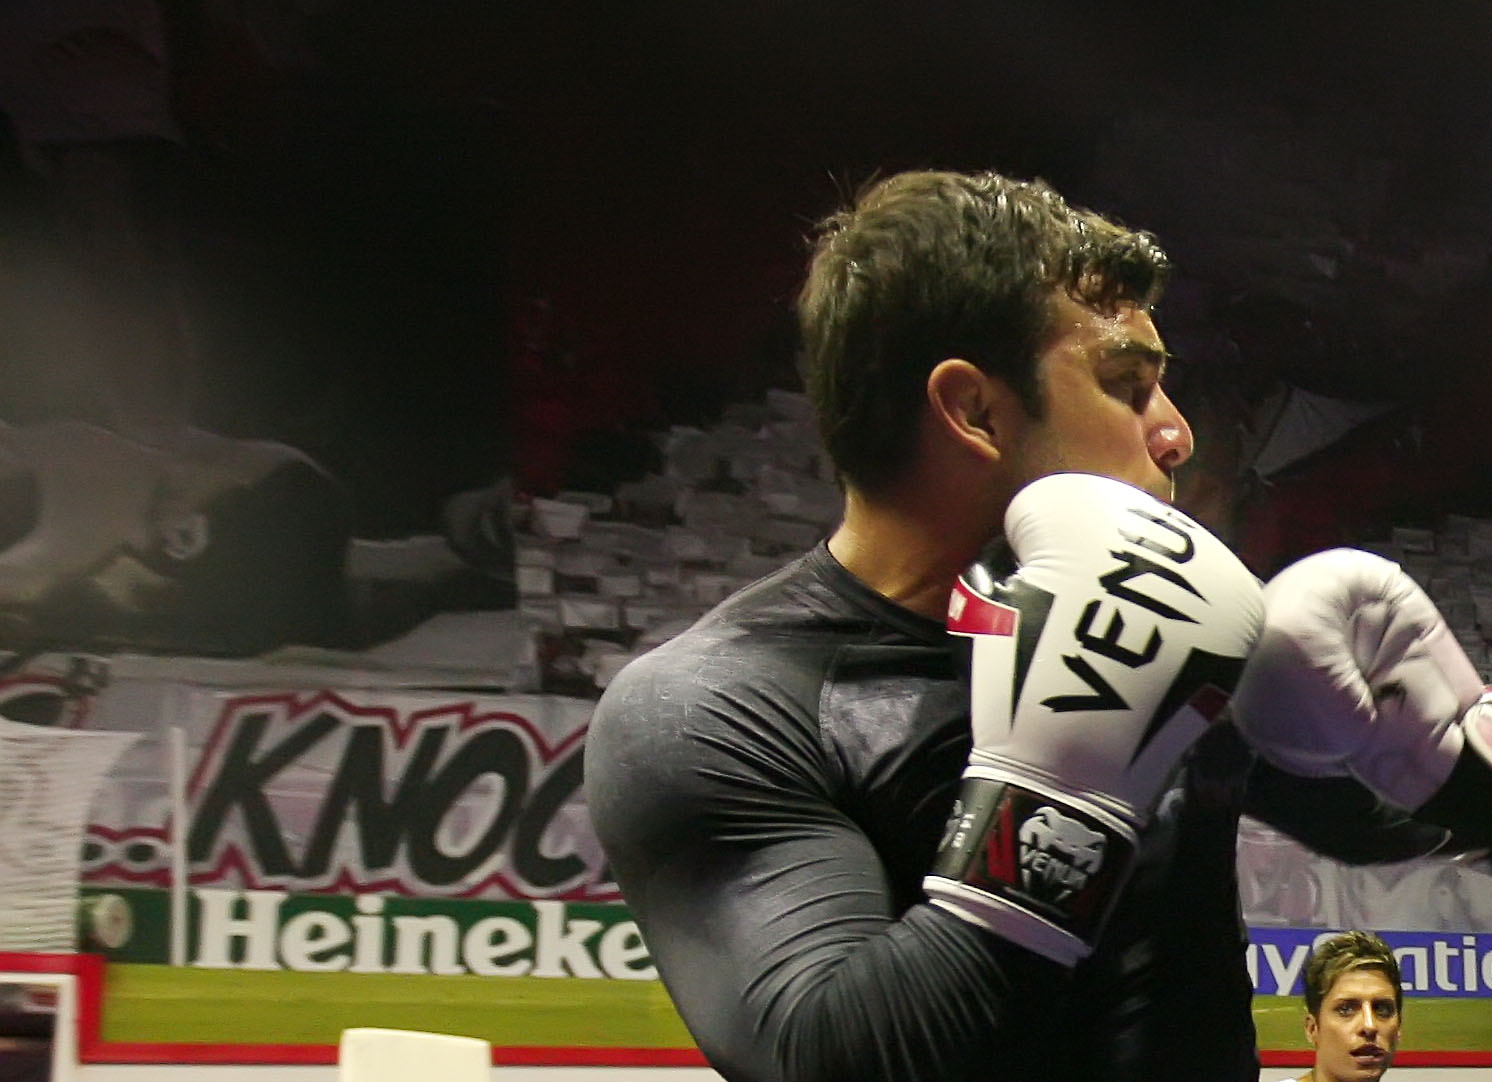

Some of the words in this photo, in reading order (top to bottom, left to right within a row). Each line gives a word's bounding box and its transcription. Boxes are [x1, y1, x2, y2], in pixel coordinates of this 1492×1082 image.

[1039, 507, 1212, 713] VENU
[187, 709, 590, 888] KNOC
[192, 889, 660, 981] Heineke
